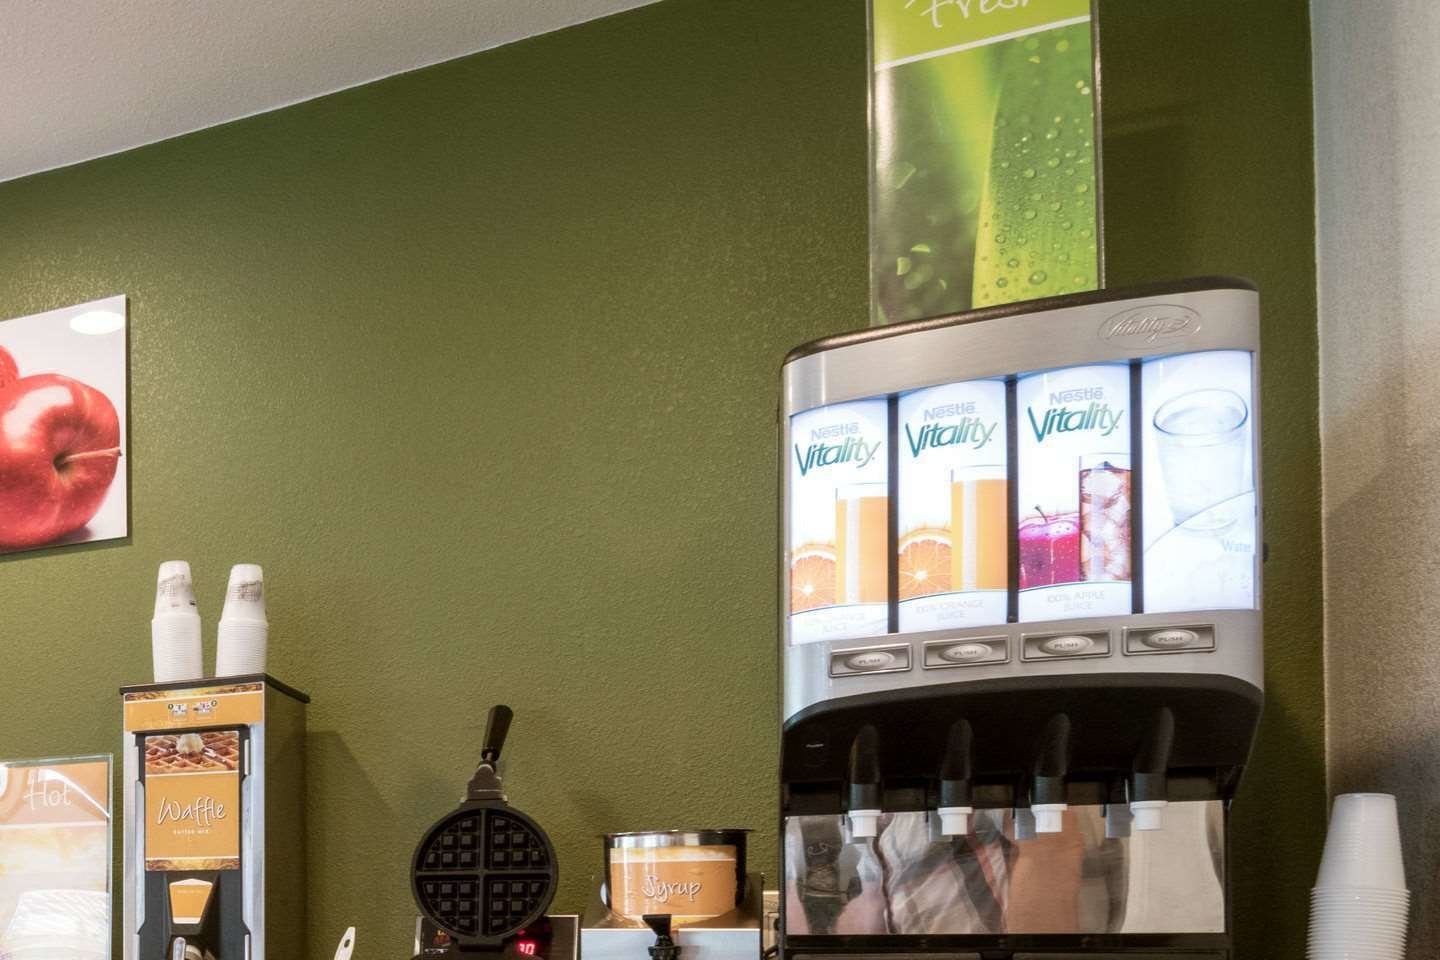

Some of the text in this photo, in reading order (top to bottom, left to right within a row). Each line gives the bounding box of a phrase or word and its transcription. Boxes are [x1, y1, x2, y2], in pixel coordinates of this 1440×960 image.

[905, 417, 998, 458] Vitality
[1027, 402, 1125, 442] Vitality
[794, 435, 882, 477] Vitality
[157, 796, 227, 826] Waffle
[641, 875, 703, 903] Syrup
